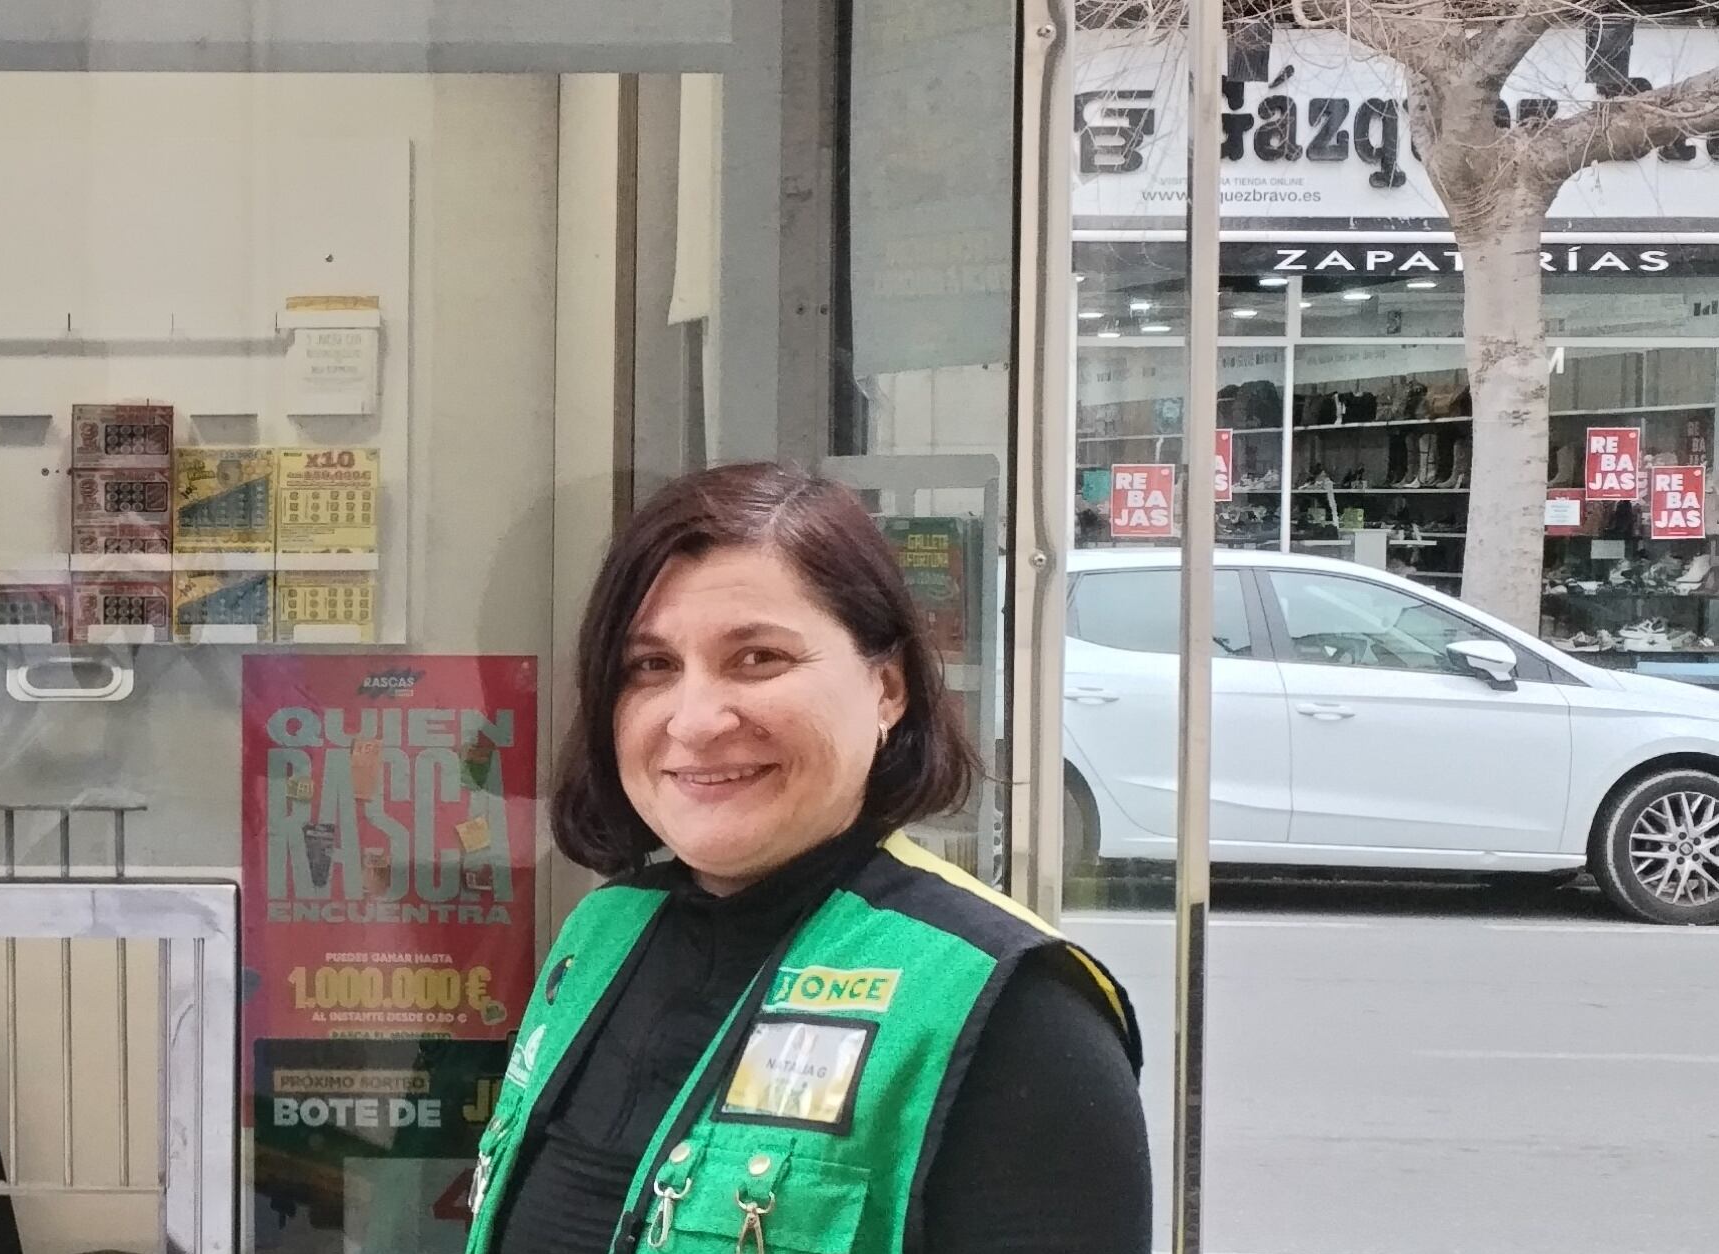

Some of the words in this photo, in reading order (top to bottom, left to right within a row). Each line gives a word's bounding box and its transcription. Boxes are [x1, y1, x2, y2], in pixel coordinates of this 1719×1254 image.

[1272, 246, 1670, 272] ZAPATRÍAS
[1590, 436, 1619, 454] RE
[1601, 454, 1634, 471] BA
[1115, 472, 1148, 490] RE
[1589, 473, 1635, 490] JAS
[1655, 473, 1684, 491] RE
[1127, 490, 1168, 507] BA
[1666, 492, 1701, 509] BA
[1114, 509, 1169, 527] JAS
[1655, 511, 1702, 528] JAS
[363, 676, 415, 688] RASCAS
[266, 707, 514, 748] QUIEN
[267, 748, 514, 901] RASCA
[267, 902, 512, 924] ENCUENTRA
[325, 951, 369, 963] PUEDES
[371, 952, 413, 963] GANAR
[415, 953, 453, 964] HASTA
[800, 974, 889, 1001] ONCE
[312, 1012, 326, 1022] AL
[386, 1012, 423, 1023] DESDE
[273, 1097, 379, 1127] BOTE
[388, 1098, 442, 1128] DE
